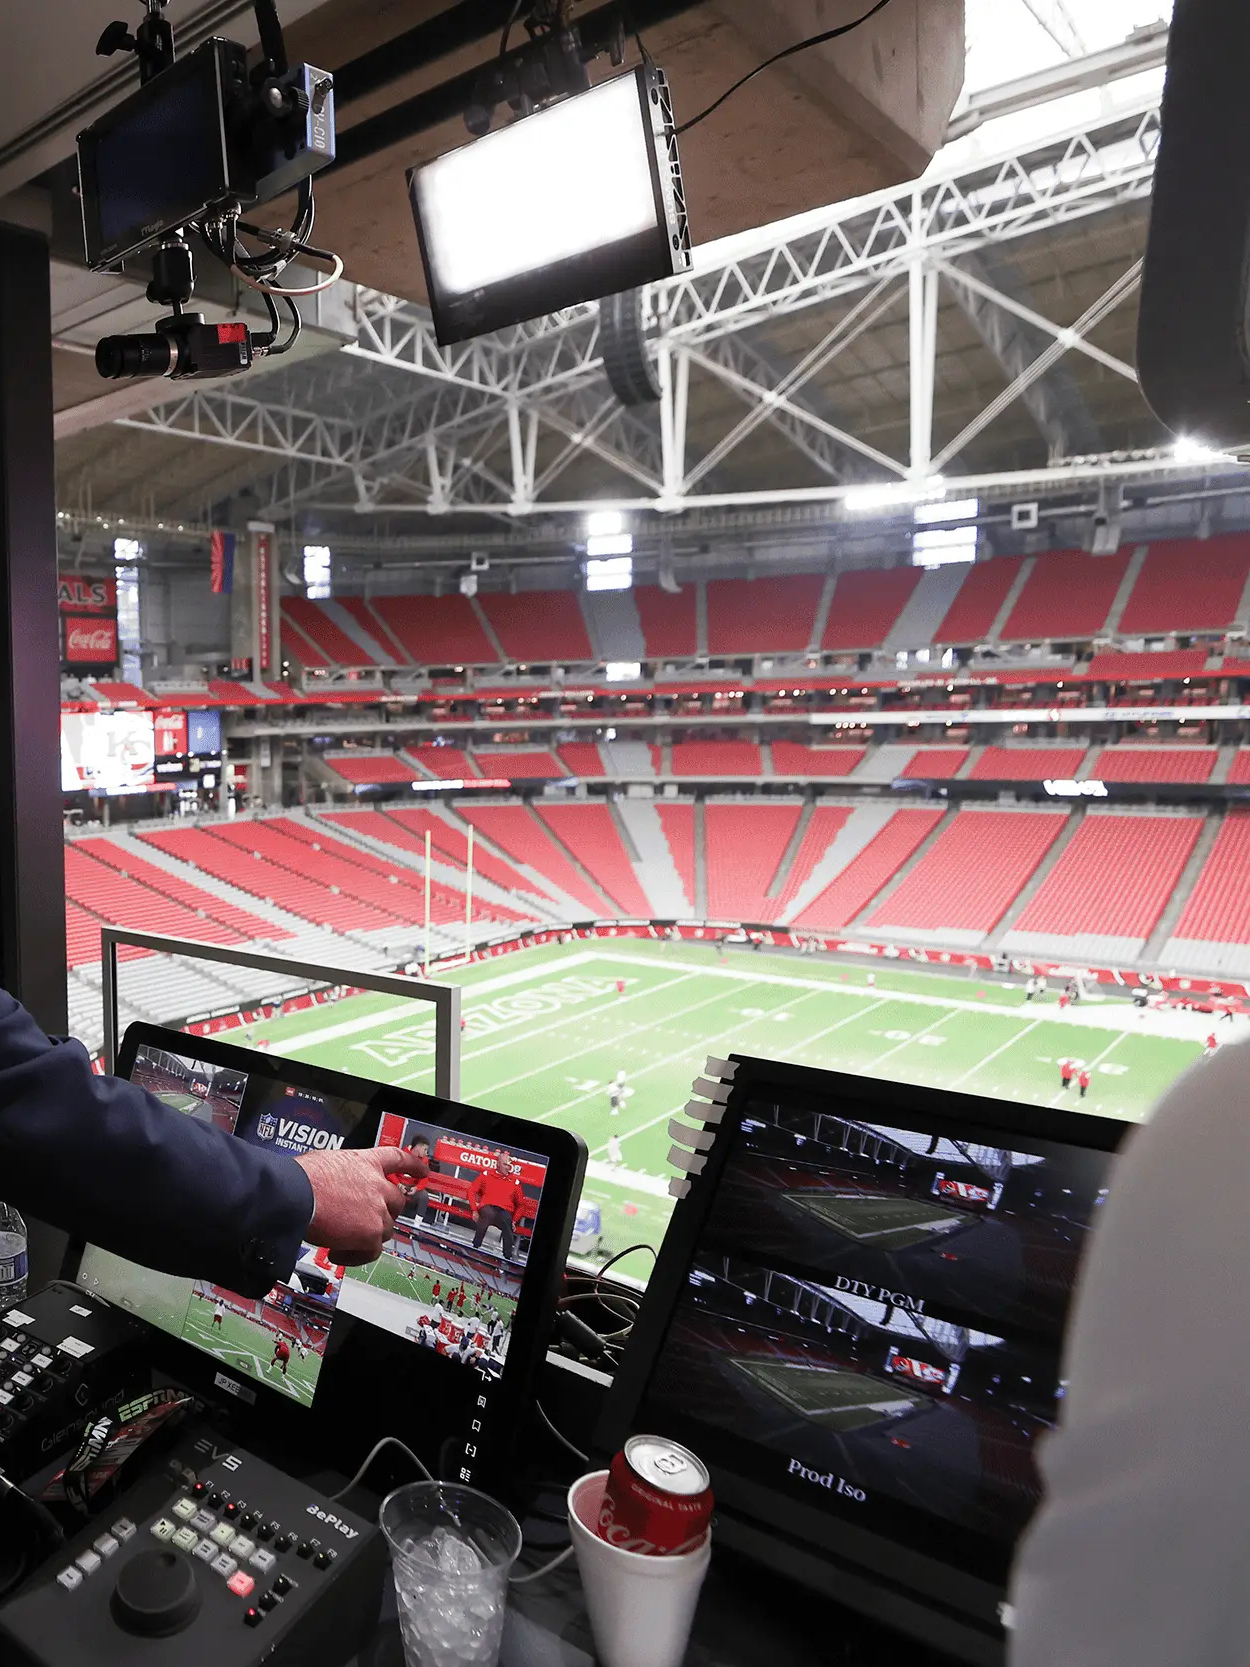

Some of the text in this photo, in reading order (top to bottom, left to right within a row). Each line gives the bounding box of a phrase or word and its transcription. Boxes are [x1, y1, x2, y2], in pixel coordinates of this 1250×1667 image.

[275, 1138, 308, 1153] INSTANT
[278, 1118, 345, 1150] VISION
[834, 1275, 926, 1313] DTY PGM
[117, 1388, 165, 1423] ESPN
[193, 1438, 243, 1472] EVS
[787, 1458, 866, 1502] Prod Iso
